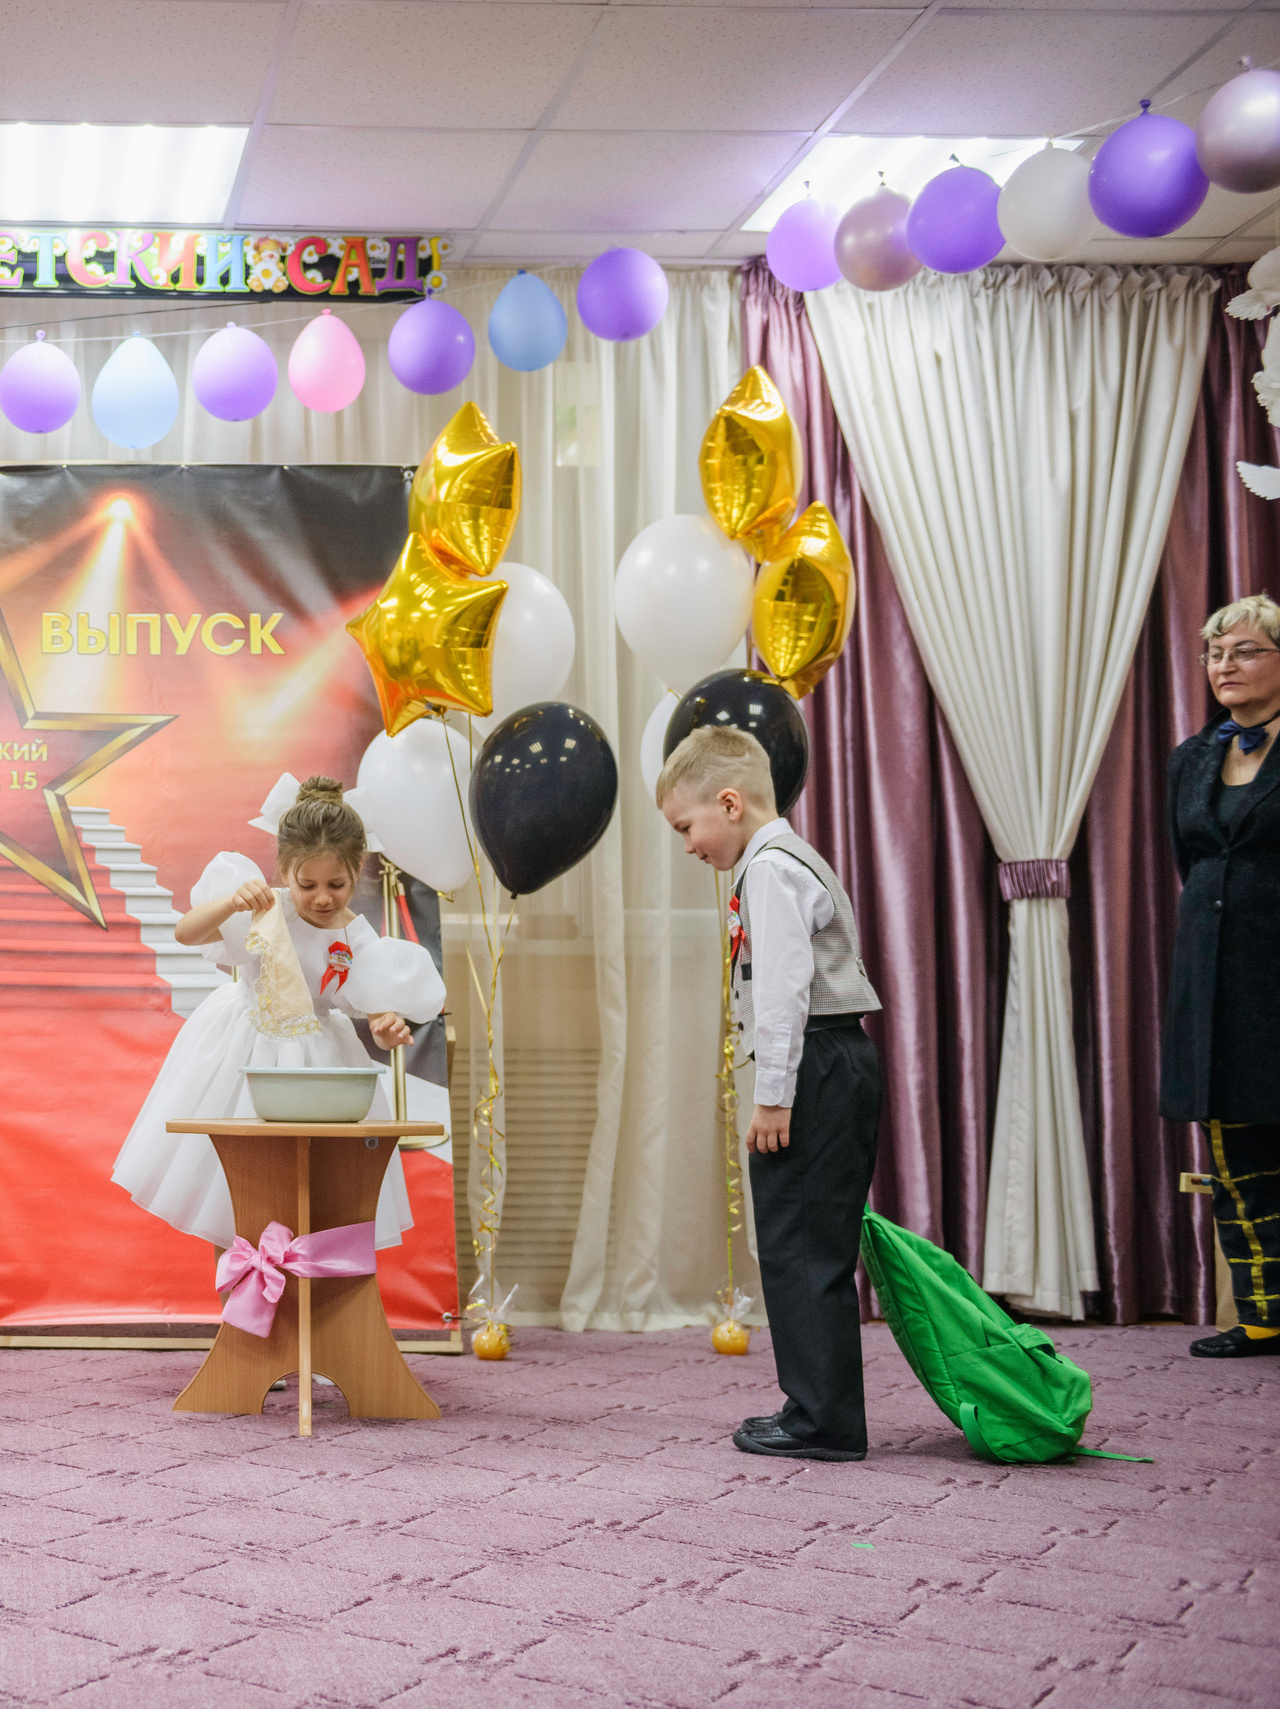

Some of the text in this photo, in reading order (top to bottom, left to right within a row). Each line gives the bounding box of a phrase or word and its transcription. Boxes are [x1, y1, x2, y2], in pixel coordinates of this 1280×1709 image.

[286, 236, 448, 296] САД!
[41, 611, 286, 656] ВЫПУСК
[9, 770, 38, 790] 15
